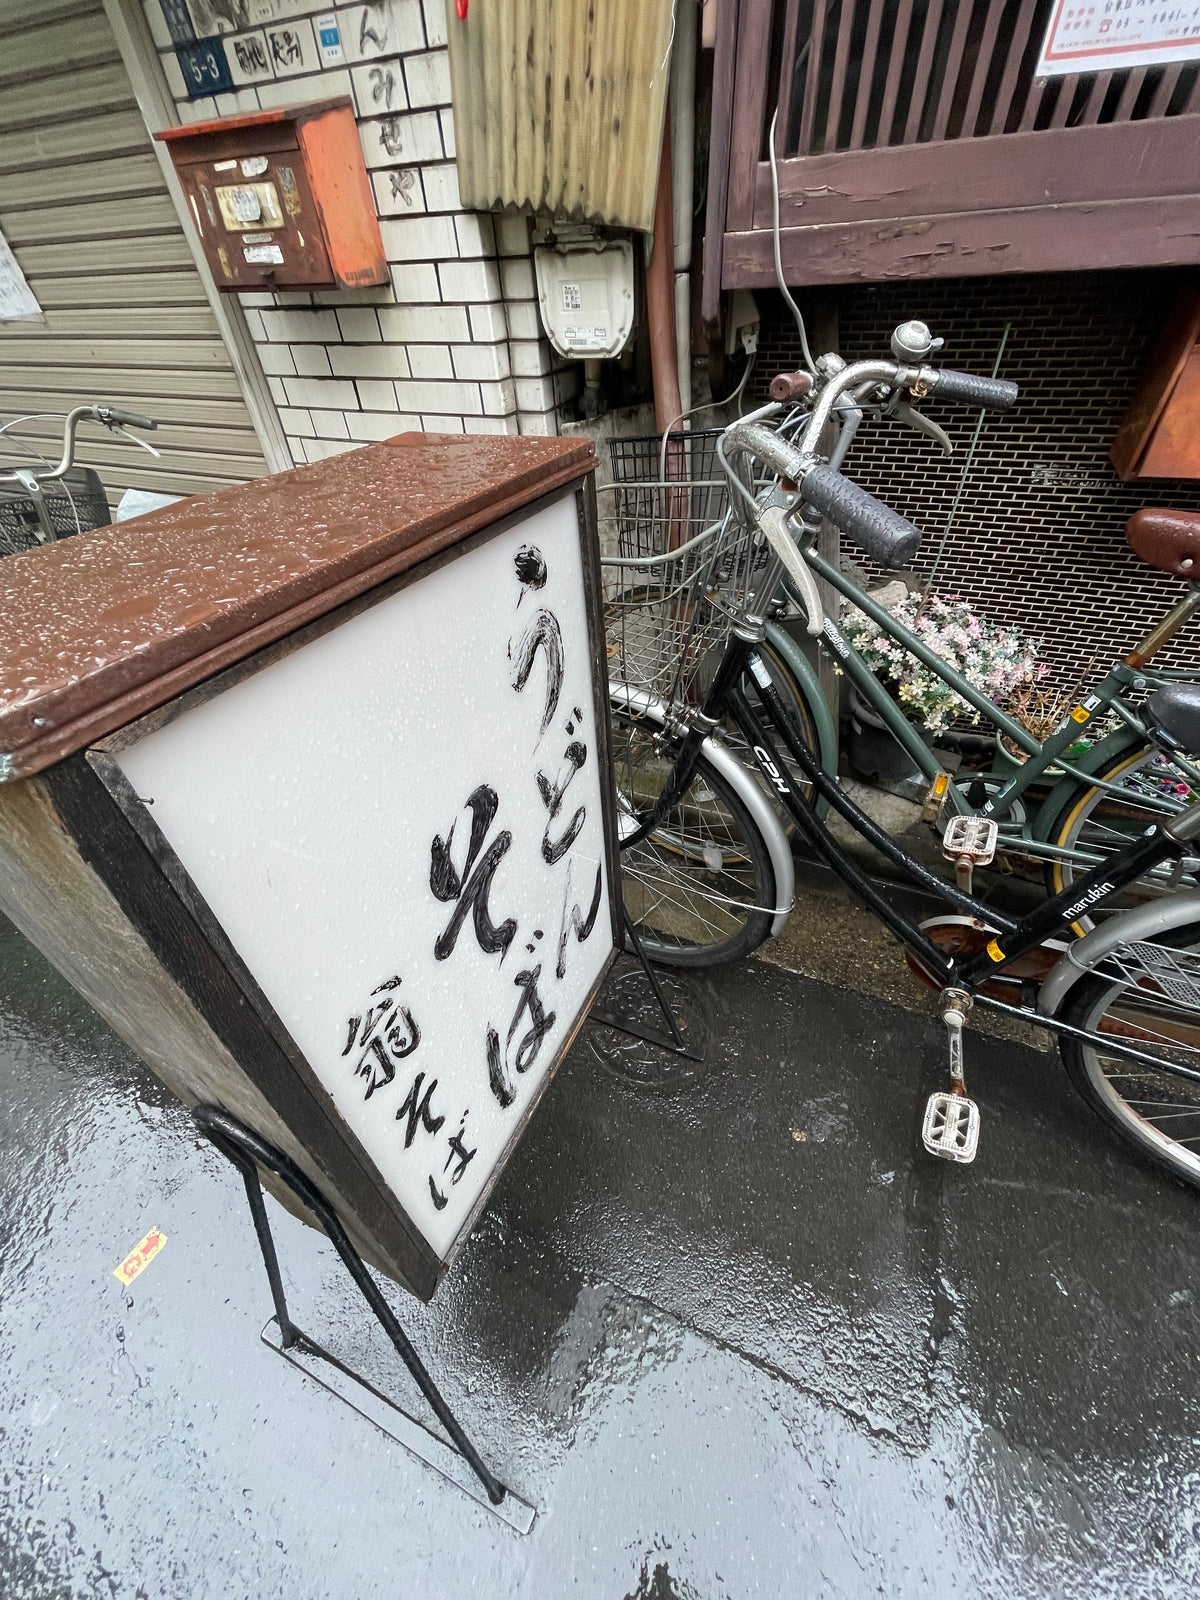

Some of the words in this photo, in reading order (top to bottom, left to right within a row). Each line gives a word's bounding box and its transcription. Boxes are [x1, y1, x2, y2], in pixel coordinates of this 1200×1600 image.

[189, 54, 220, 83] 5-3
[507, 543, 602, 980] うどん
[430, 783, 557, 1109] そば
[1062, 882, 1115, 919] marukin
